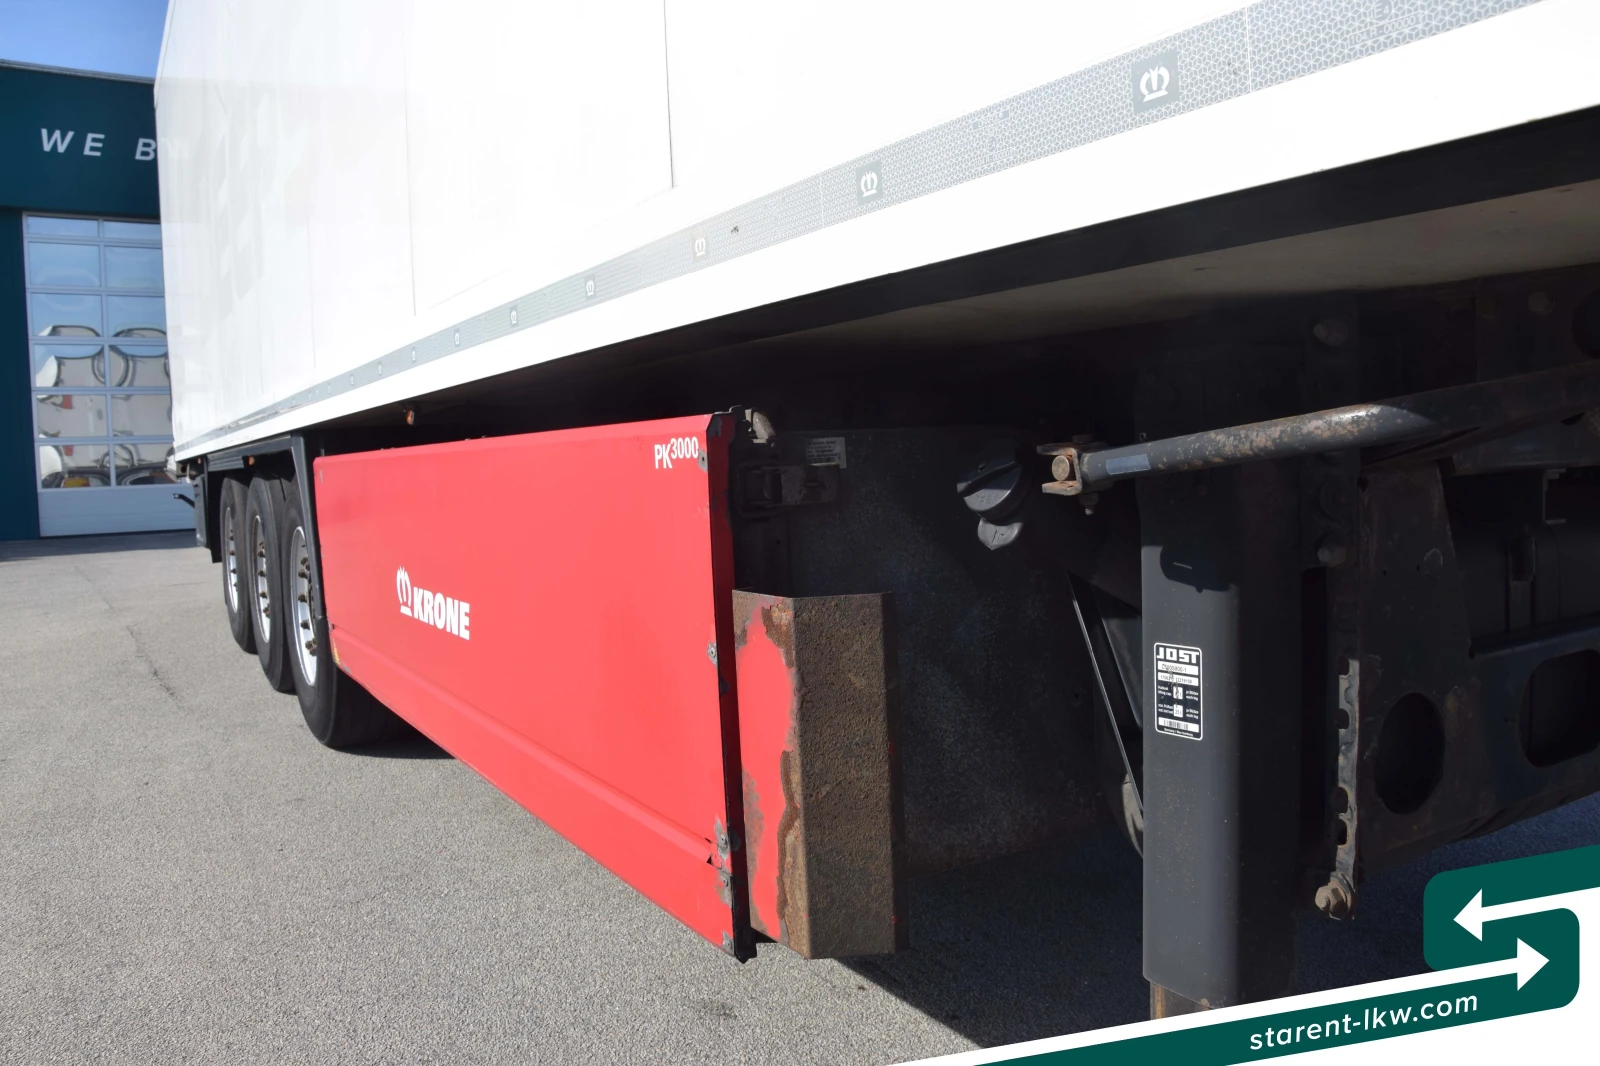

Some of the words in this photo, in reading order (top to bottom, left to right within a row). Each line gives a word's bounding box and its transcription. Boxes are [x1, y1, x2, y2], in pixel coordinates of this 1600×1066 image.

[41, 128, 105, 157] WE
[654, 436, 699, 469] PK3000
[413, 586, 470, 641] KRONE
[1156, 647, 1200, 664] JOST
